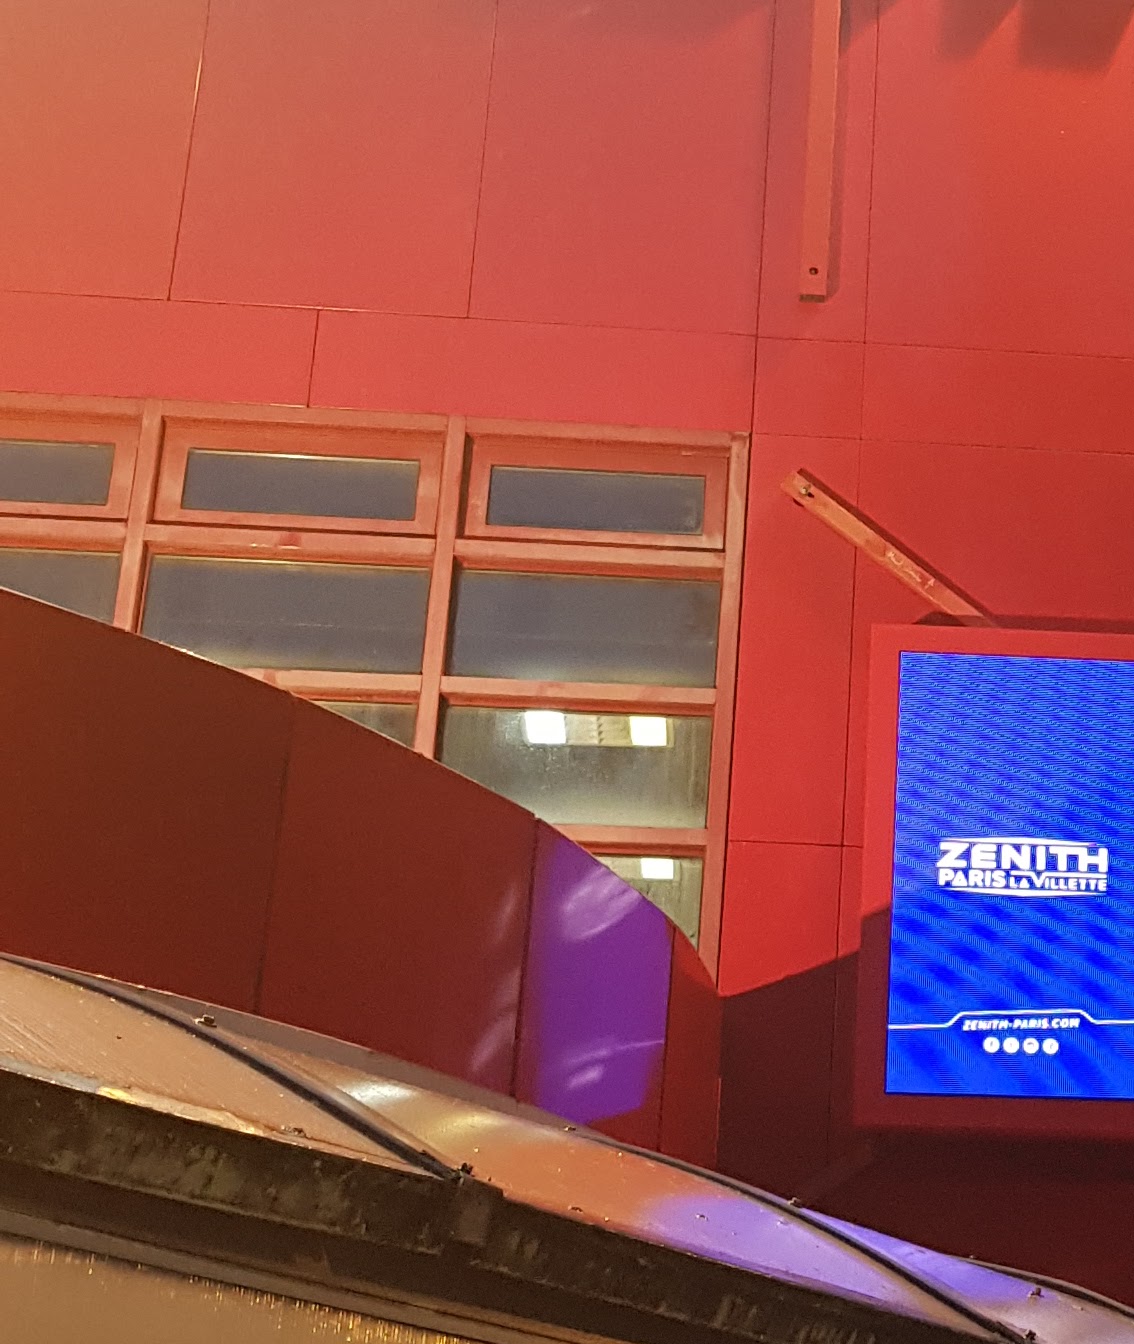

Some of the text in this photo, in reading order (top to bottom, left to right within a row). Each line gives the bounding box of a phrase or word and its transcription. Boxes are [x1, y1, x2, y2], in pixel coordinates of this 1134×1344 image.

[936, 841, 1109, 873] ZENITH
[938, 868, 1007, 888] PARIS
[1031, 873, 1108, 892] VILLETTE
